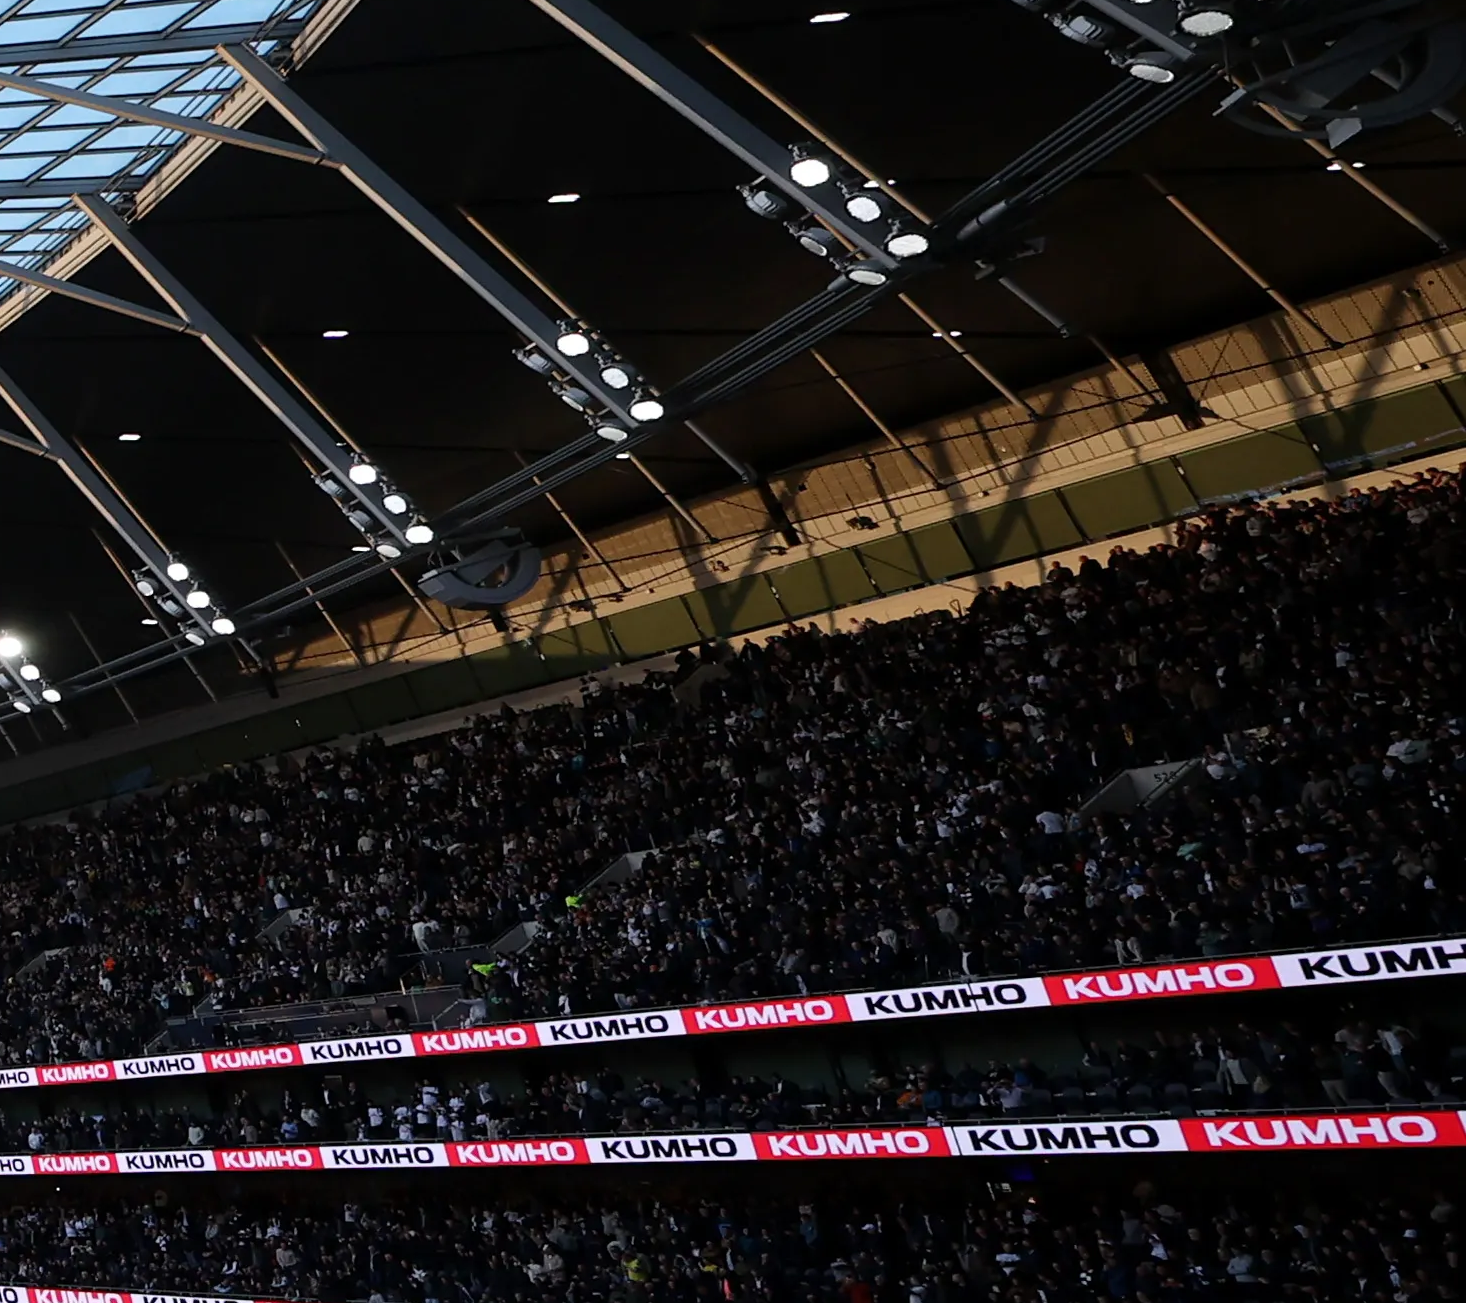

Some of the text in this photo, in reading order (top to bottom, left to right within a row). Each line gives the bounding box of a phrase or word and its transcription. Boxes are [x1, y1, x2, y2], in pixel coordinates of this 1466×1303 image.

[1063, 961, 1254, 1001] KUMHO
[864, 982, 1027, 1017] KUMHO
[695, 999, 833, 1031] KUMHO
[550, 1014, 669, 1042] KUMHO
[310, 1038, 402, 1061] KUMHO
[422, 1027, 527, 1053] KUMHO
[123, 1056, 195, 1076] KUMHO
[210, 1046, 293, 1070] KUMHO
[42, 1063, 109, 1084] KUMHO
[969, 1123, 1160, 1152] KUMHO
[1203, 1116, 1436, 1147] KUMHO
[456, 1141, 575, 1163] KUMHO
[601, 1137, 737, 1160] KUMHO
[768, 1131, 929, 1157] KUMHO
[38, 1155, 111, 1172] KUMHO
[126, 1153, 205, 1170] KUMHO
[222, 1149, 312, 1169] KUMHO
[332, 1146, 434, 1166] KUMHO
